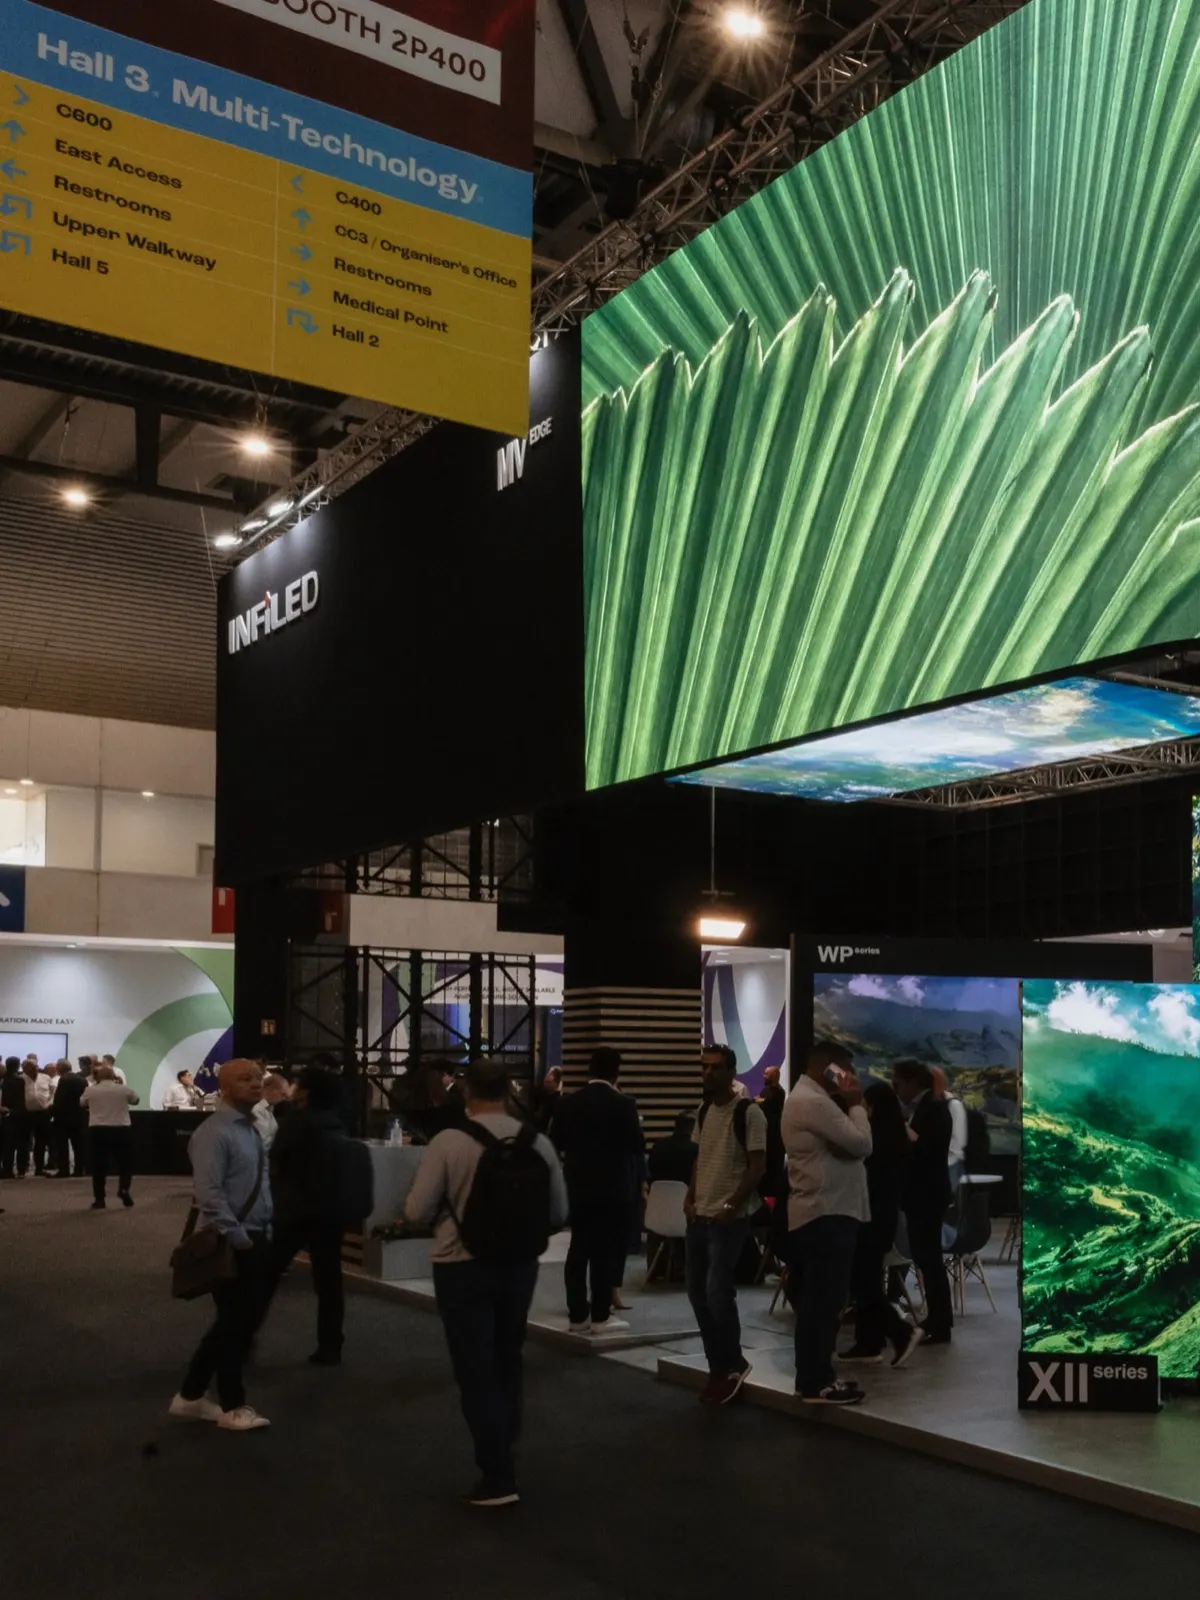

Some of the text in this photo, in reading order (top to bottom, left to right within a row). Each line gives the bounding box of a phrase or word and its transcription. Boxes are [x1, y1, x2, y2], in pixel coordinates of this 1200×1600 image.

[37, 32, 114, 83] Hall
[263, 0, 486, 82] OOTH 2P400
[56, 103, 113, 132] C600
[55, 138, 183, 190] East Access
[54, 175, 172, 222] Restrooms
[335, 190, 382, 216] C400
[52, 248, 109, 275] Hall 5
[53, 211, 217, 271] Upper Walkway
[335, 224, 369, 245] CC3
[380, 239, 470, 275] Organiser's
[473, 267, 517, 289] Office
[334, 256, 432, 297] Restrooms
[333, 290, 449, 333] Medical Point
[332, 324, 380, 348] Hall 2
[529, 416, 552, 445] EDGE
[817, 945, 880, 963] WP series
[1027, 1361, 1148, 1403] XII series
